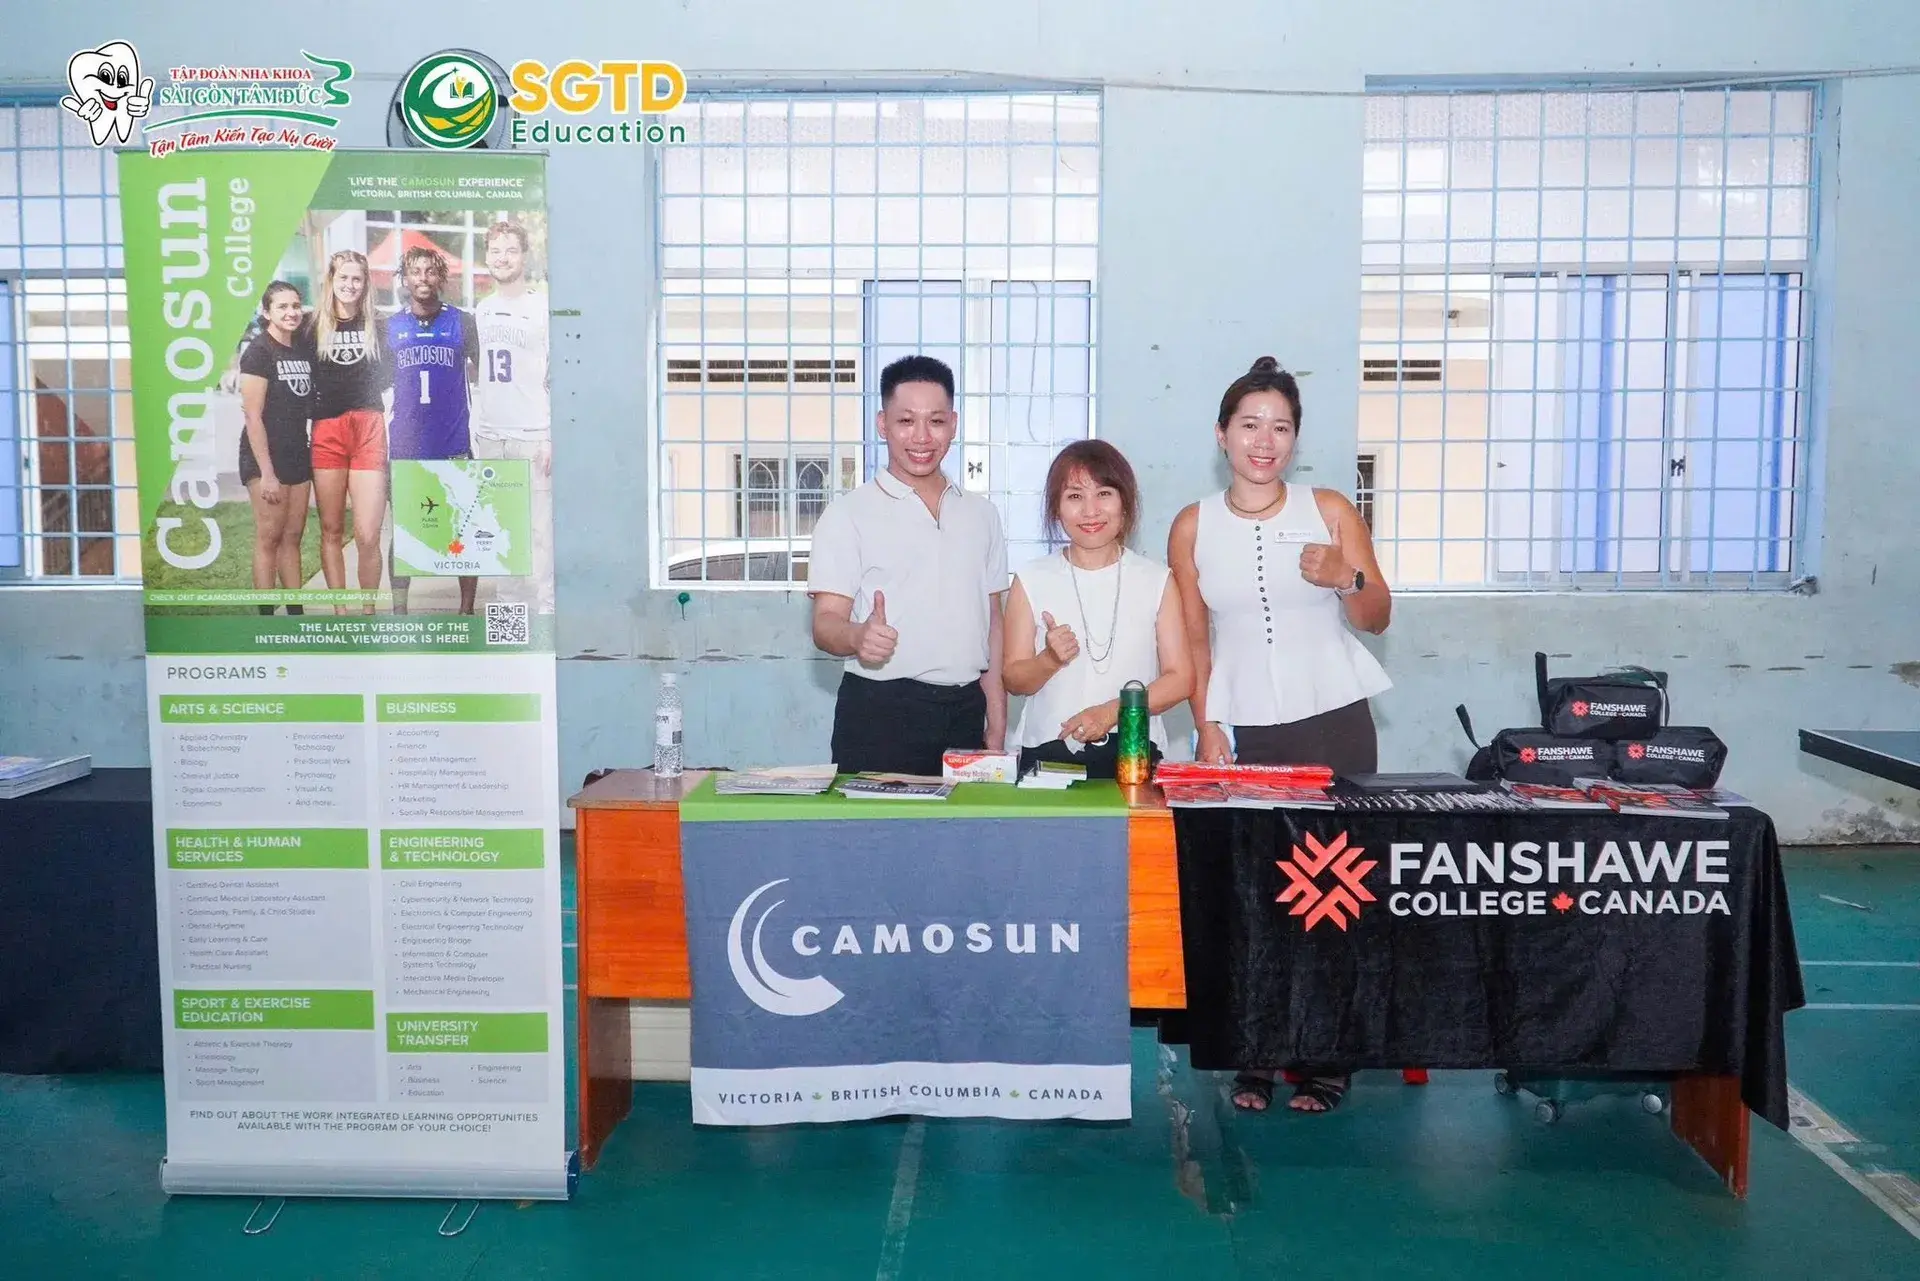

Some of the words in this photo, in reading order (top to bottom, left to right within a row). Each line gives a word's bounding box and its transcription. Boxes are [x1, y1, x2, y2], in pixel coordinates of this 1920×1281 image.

[377, 178, 398, 187] THE
[401, 177, 456, 187] CAMOSUN
[398, 190, 432, 198] BRITISH
[486, 191, 523, 199] CANADA
[224, 176, 255, 297] College
[397, 345, 454, 369] CAMOSUN
[488, 349, 512, 382] 13
[156, 176, 222, 570] Camosun
[419, 370, 431, 404] 1
[335, 593, 370, 601] CAMPUS
[299, 623, 322, 632] THE
[326, 624, 366, 632] LATEST
[371, 623, 424, 632] VERSION
[428, 623, 443, 631] OF
[447, 623, 470, 631] THE
[255, 635, 348, 644] INTERNATIONAL
[351, 635, 417, 644] VIEWBOOK
[421, 635, 432, 643] IS
[436, 635, 470, 643] HERE!
[167, 666, 267, 679] PROGRAMS
[169, 703, 205, 715] ARTS
[209, 703, 218, 714] &
[222, 703, 284, 714] SCIENCE
[386, 702, 456, 714] BUSINESS
[1590, 702, 1646, 712] FANSHAWE
[396, 730, 439, 738] Accounting
[1538, 747, 1593, 756] FANSHAWE
[1646, 745, 1705, 758] FANSHAWE
[180, 759, 208, 767] Biology
[429, 756, 476, 764] Management
[176, 837, 229, 848] HEALTH
[233, 837, 243, 847] &
[247, 837, 301, 847] HUMAN
[389, 837, 484, 848] ENGINEERING
[176, 851, 244, 862] SERVICES
[389, 852, 399, 862] &
[404, 851, 500, 862] TECHNOLOGY
[1390, 840, 1730, 884] FANSHAWE
[418, 880, 462, 888] Engineering
[1389, 891, 1547, 916] COLLEGE
[1579, 890, 1732, 916] CANADA
[791, 923, 1080, 956] CAMOSUN
[182, 998, 228, 1009] SPORT
[231, 998, 240, 1008] &
[244, 998, 311, 1009] EXERCISE
[182, 1012, 263, 1022] EDUCATION
[396, 1021, 479, 1032] UNIVERSITY
[397, 1035, 469, 1046] TRANSFER
[719, 1092, 803, 1104] VICTORIA
[831, 1085, 901, 1101] BRITISH
[909, 1085, 1000, 1098] COLUMBIA
[1029, 1089, 1103, 1100] CANADA
[189, 1111, 213, 1119] FIND
[216, 1111, 237, 1119] OUT
[241, 1111, 278, 1119] ABOUT
[303, 1112, 332, 1120] WORK
[336, 1112, 399, 1121] INTEGRATED
[402, 1113, 453, 1121] LEARNING
[456, 1113, 538, 1122] OPPORTUNITIES
[237, 1122, 291, 1130] AVAILABLE
[324, 1123, 343, 1131] THE
[346, 1123, 397, 1131] PROGRAM
[418, 1124, 446, 1132] YOUR
[449, 1124, 491, 1133] CHOICE!
